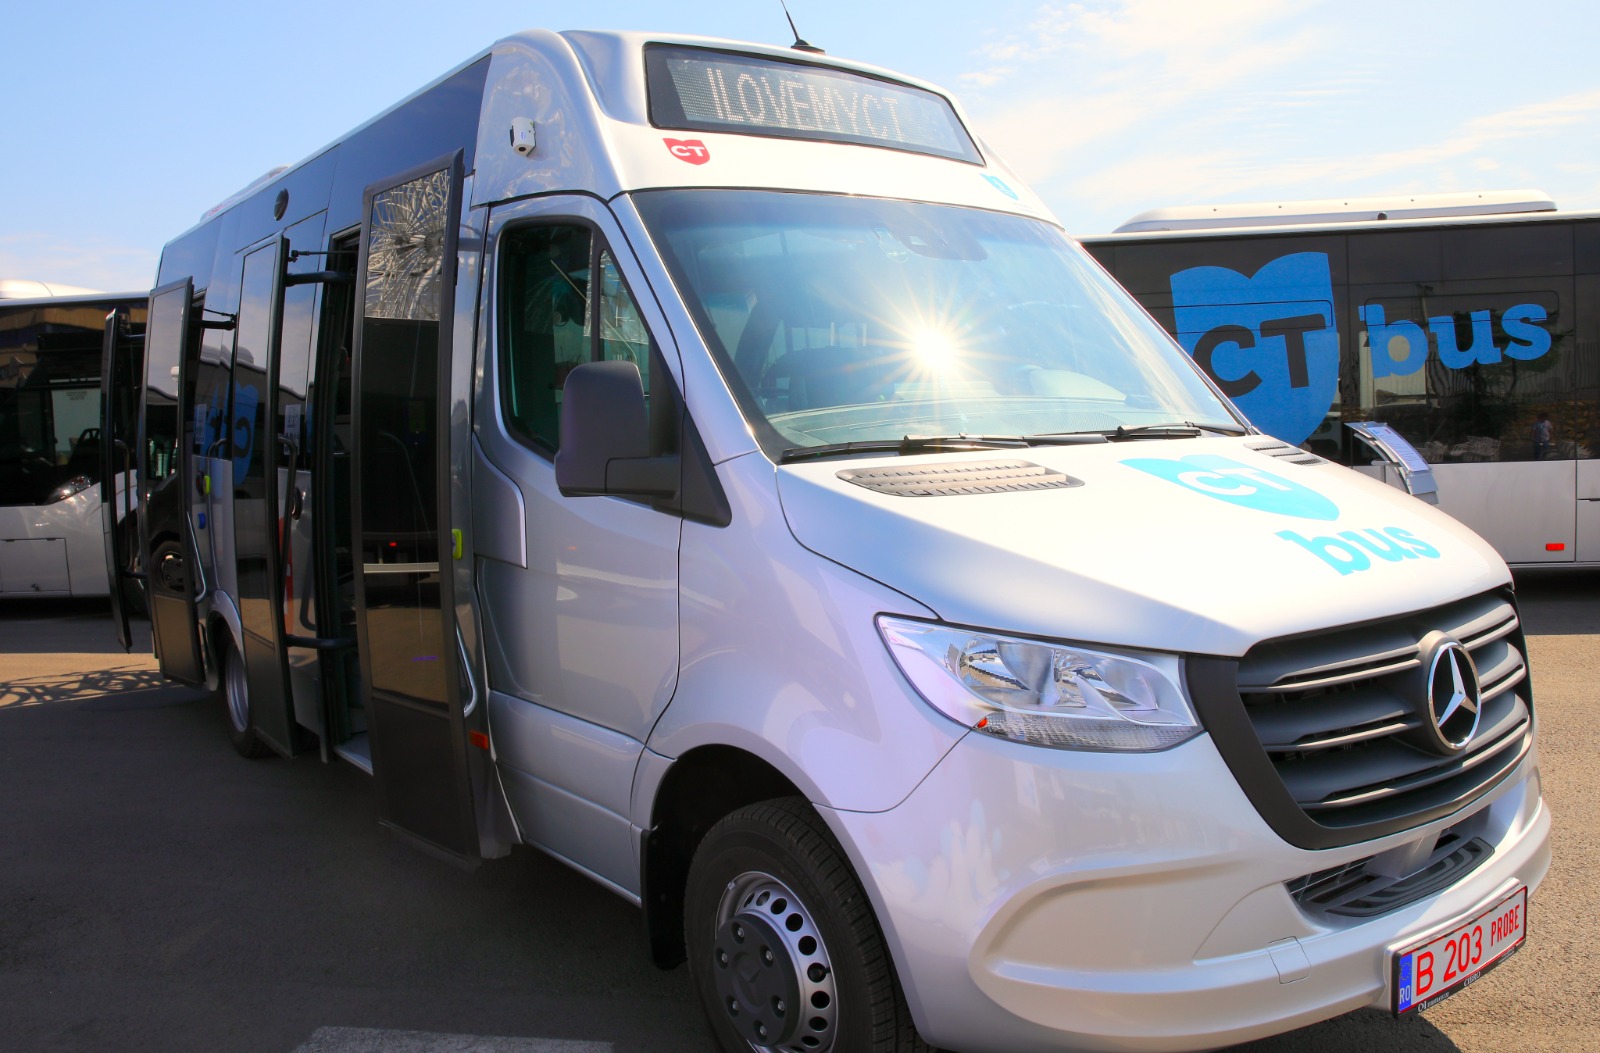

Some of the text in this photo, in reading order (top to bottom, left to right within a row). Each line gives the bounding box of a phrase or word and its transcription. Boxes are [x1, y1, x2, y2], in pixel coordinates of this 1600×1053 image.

[670, 145, 705, 157] CT
[1192, 303, 1552, 398] CT bus
[1176, 467, 1294, 496] CT
[1273, 526, 1441, 576] bus
[1416, 904, 1520, 997] B 203 PROBE
[1399, 984, 1411, 1004] RO
